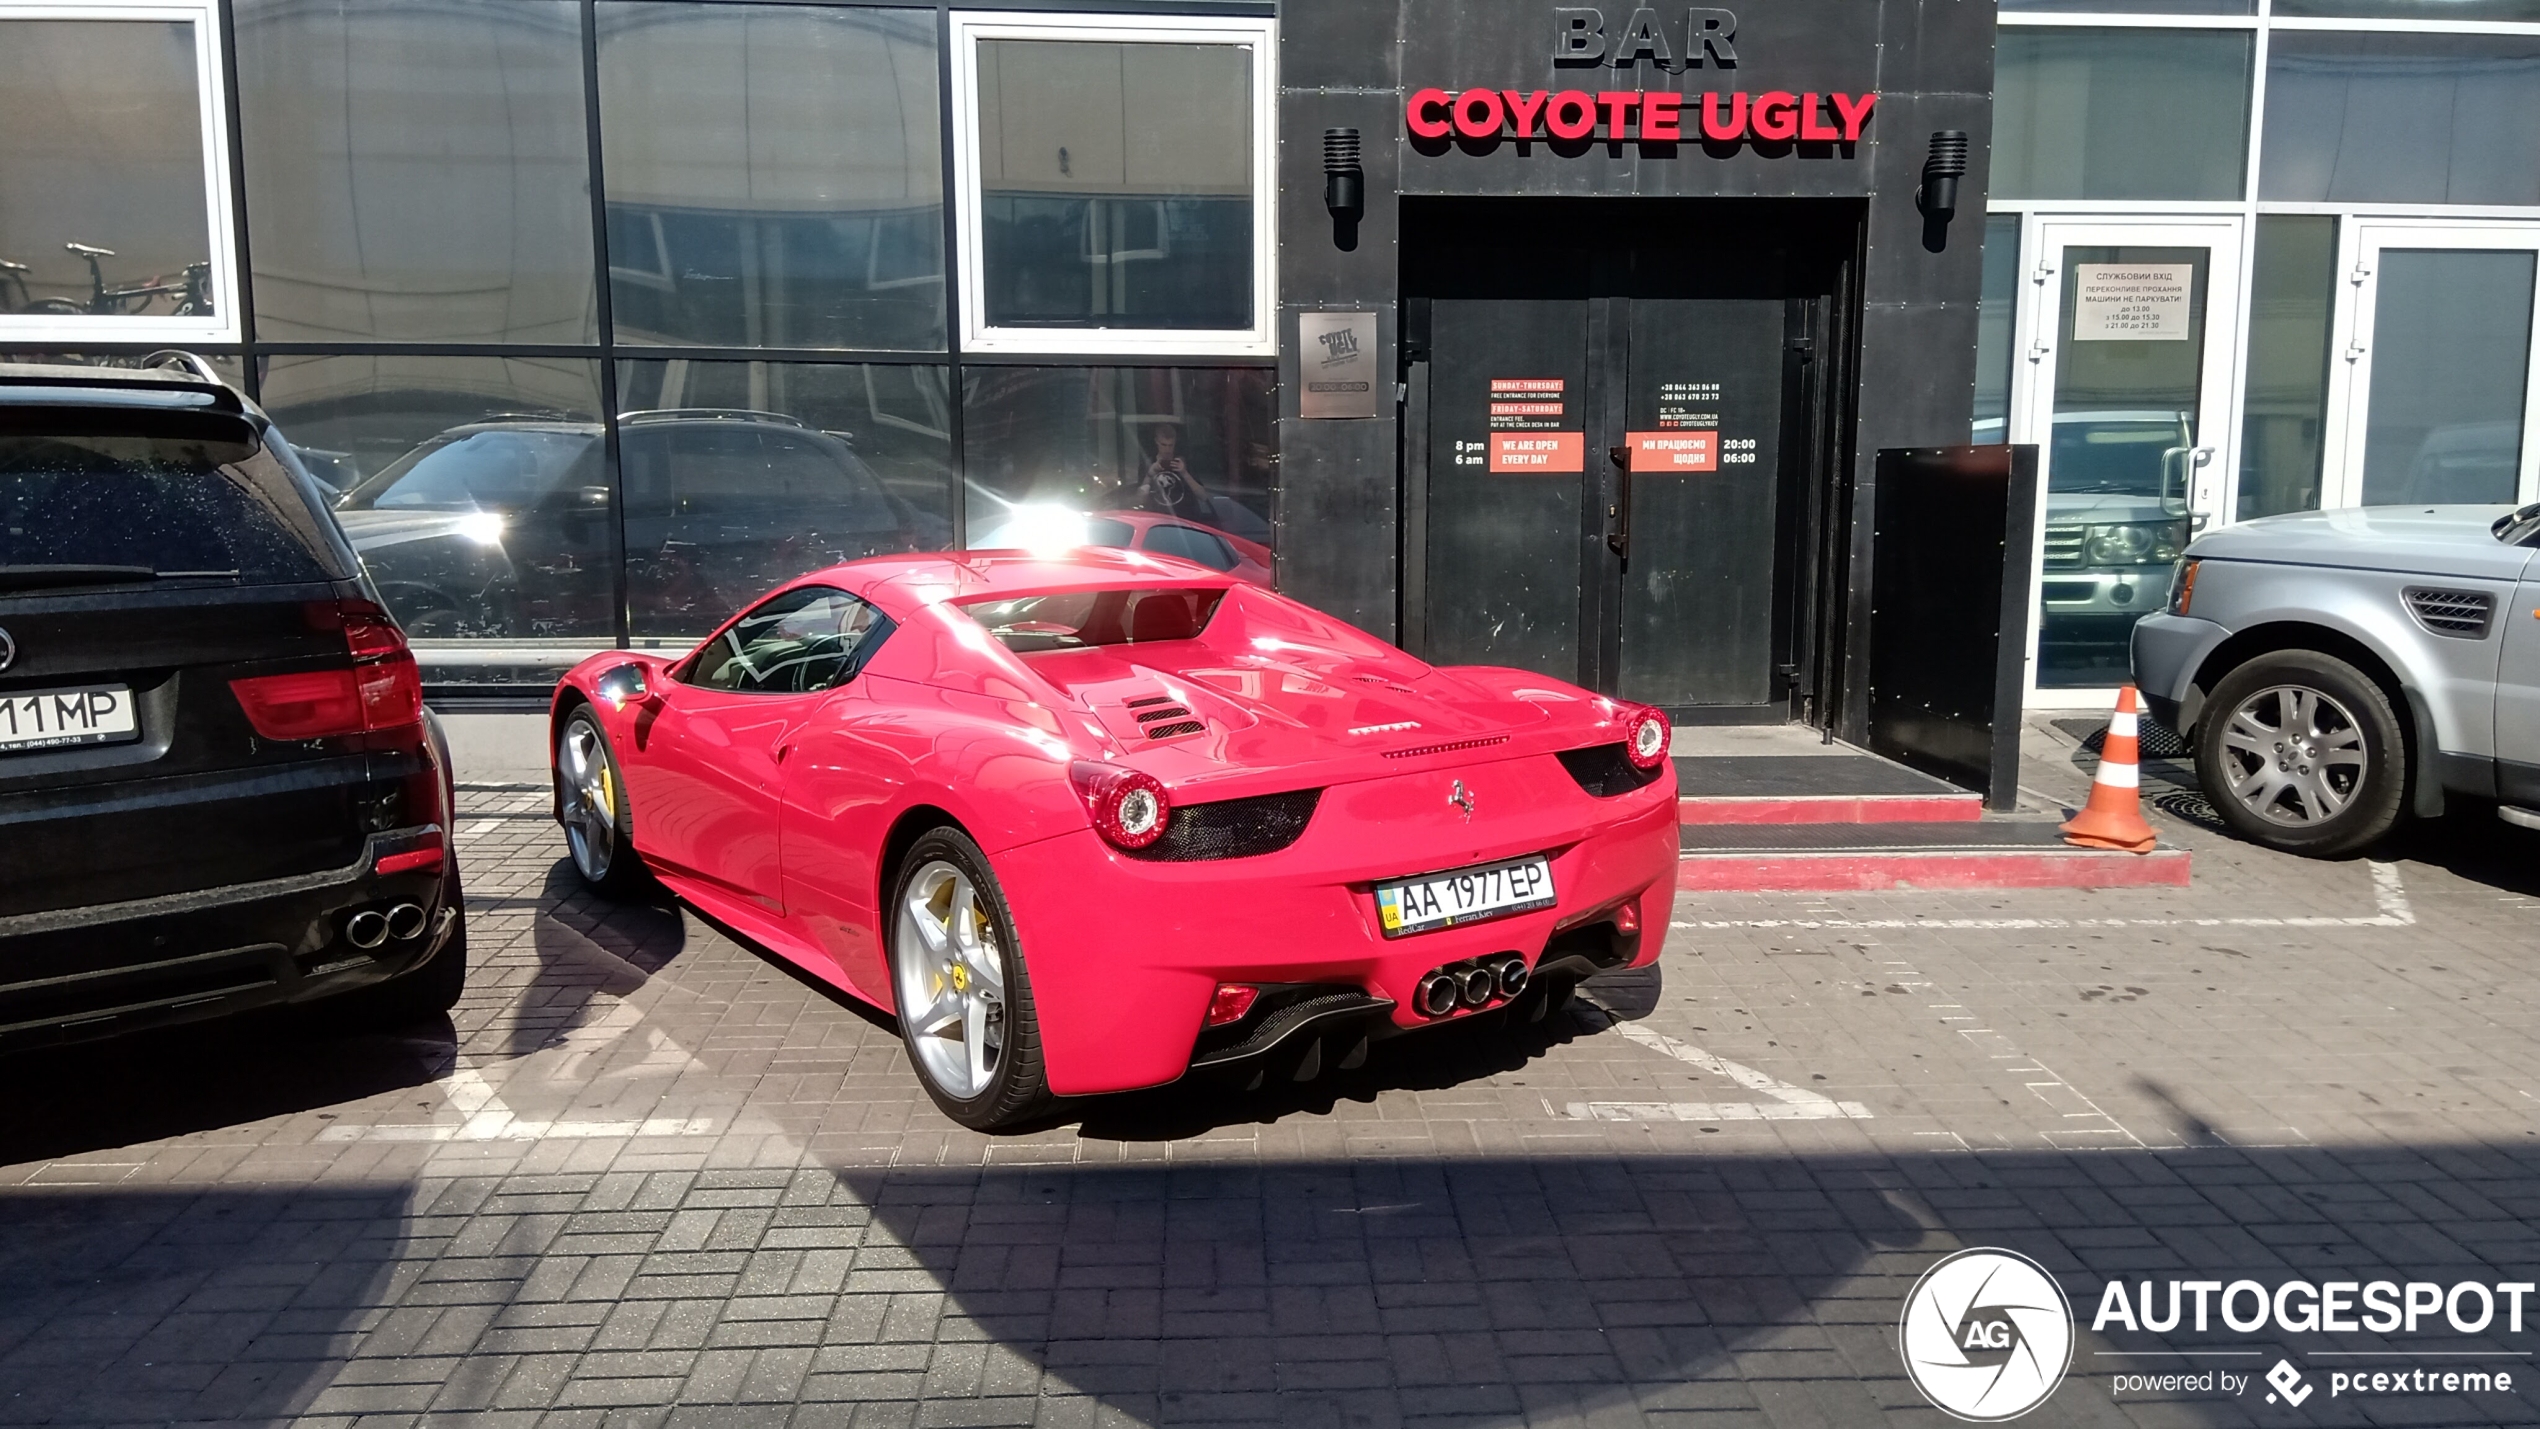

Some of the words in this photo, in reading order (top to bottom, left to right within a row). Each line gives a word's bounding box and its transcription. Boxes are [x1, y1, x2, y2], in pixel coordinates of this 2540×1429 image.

[1554, 7, 1738, 67] BAR
[1406, 88, 1680, 140] COYOTE
[1699, 91, 1875, 141] UGLY
[2153, 272, 2172, 281] ВХІД
[1492, 382, 1562, 390] SUNDAY-THURSDAY:
[1492, 405, 1562, 413] FRIDAY-SATURDAY:
[1455, 441, 1463, 451] 8
[1466, 442, 1484, 453] pm
[1502, 440, 1516, 451] WE
[1517, 440, 1534, 451] ARE
[1535, 440, 1558, 451] OPEN
[1642, 440, 1656, 450] МИ
[1657, 440, 1706, 451] ПРАЦЮЄМО
[1723, 439, 1756, 450] 20:00
[1455, 455, 1463, 465] 6
[1465, 456, 1484, 465] am
[1502, 454, 1529, 465] EVERY
[1530, 454, 1548, 465] DAY
[1673, 453, 1706, 465] ЩОДНЯ
[1723, 453, 1756, 464] 06:00
[54, 691, 117, 731] MP
[26, 740, 46, 748] (044)
[46, 736, 82, 745] 490-77-33
[1403, 882, 1442, 920] AA
[1446, 869, 1501, 909] 1977
[1508, 863, 1543, 898] EP
[1385, 911, 1399, 923] UA
[1397, 923, 1425, 936] RedCar
